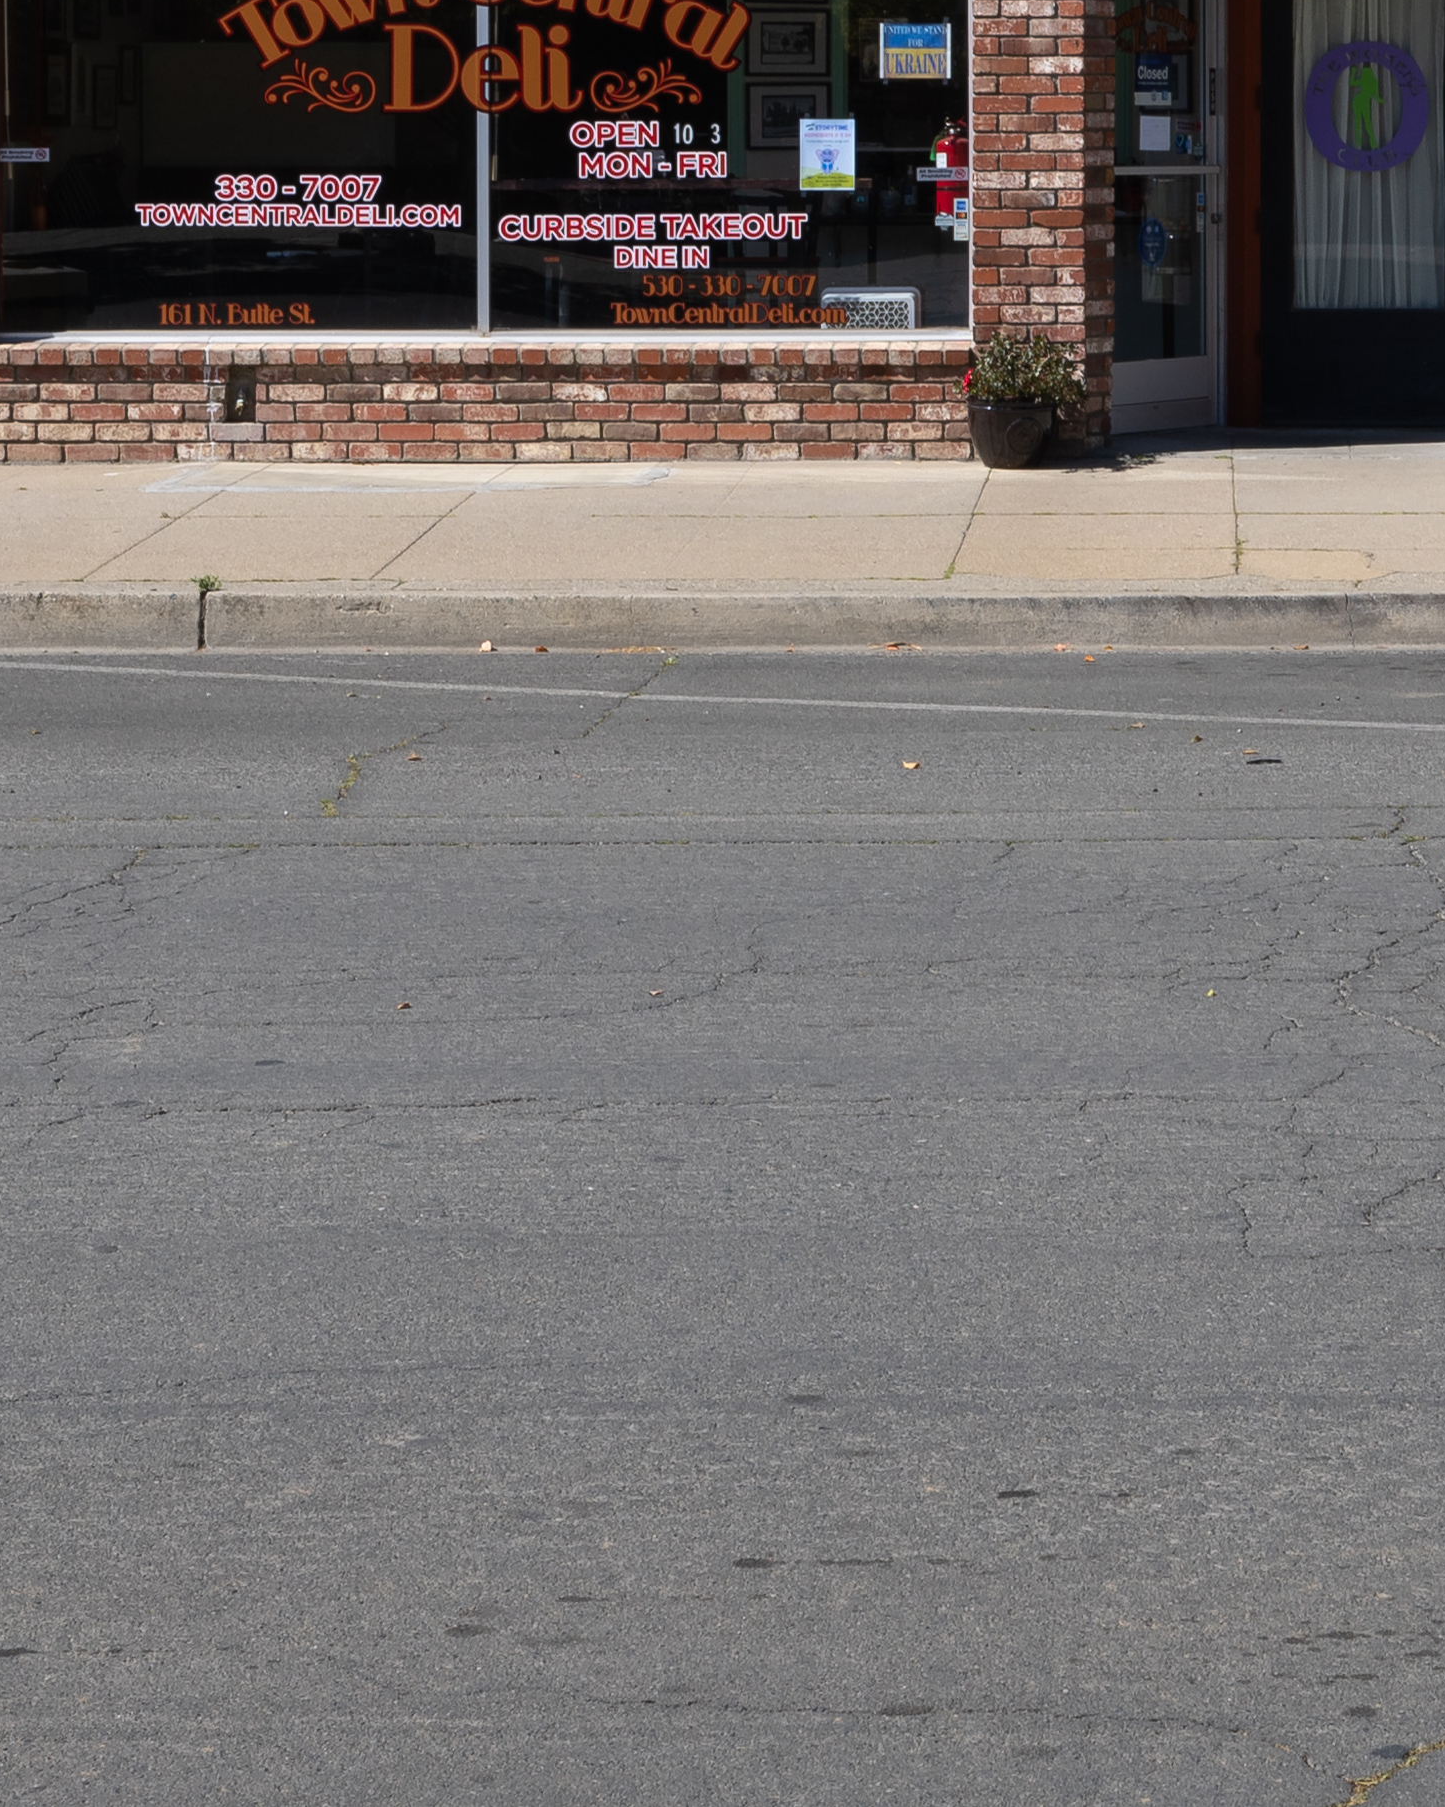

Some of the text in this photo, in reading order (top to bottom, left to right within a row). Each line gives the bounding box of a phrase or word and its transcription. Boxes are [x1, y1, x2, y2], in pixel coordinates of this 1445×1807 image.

[907, 38, 924, 47] FOR
[380, 22, 585, 115] Deli
[884, 53, 947, 74] UKRAINE
[1137, 65, 1169, 80] Closed
[569, 120, 660, 148] OPEN
[673, 122, 694, 145] 10
[710, 122, 721, 145] 3
[578, 151, 653, 180] MON
[676, 151, 727, 179] FRI
[214, 174, 277, 201] 330
[300, 174, 383, 201] 7007
[135, 203, 462, 228] TOWNCENTRALDELI.COM
[498, 213, 809, 241] CURBSIDE TAKEOUT
[613, 246, 710, 269] DINE IN
[642, 274, 684, 297] 530
[700, 274, 742, 297] 330
[757, 274, 817, 297] 7007
[158, 302, 317, 325] 161 N. Butte St.
[610, 301, 848, 326] TownCentralDeli.com
